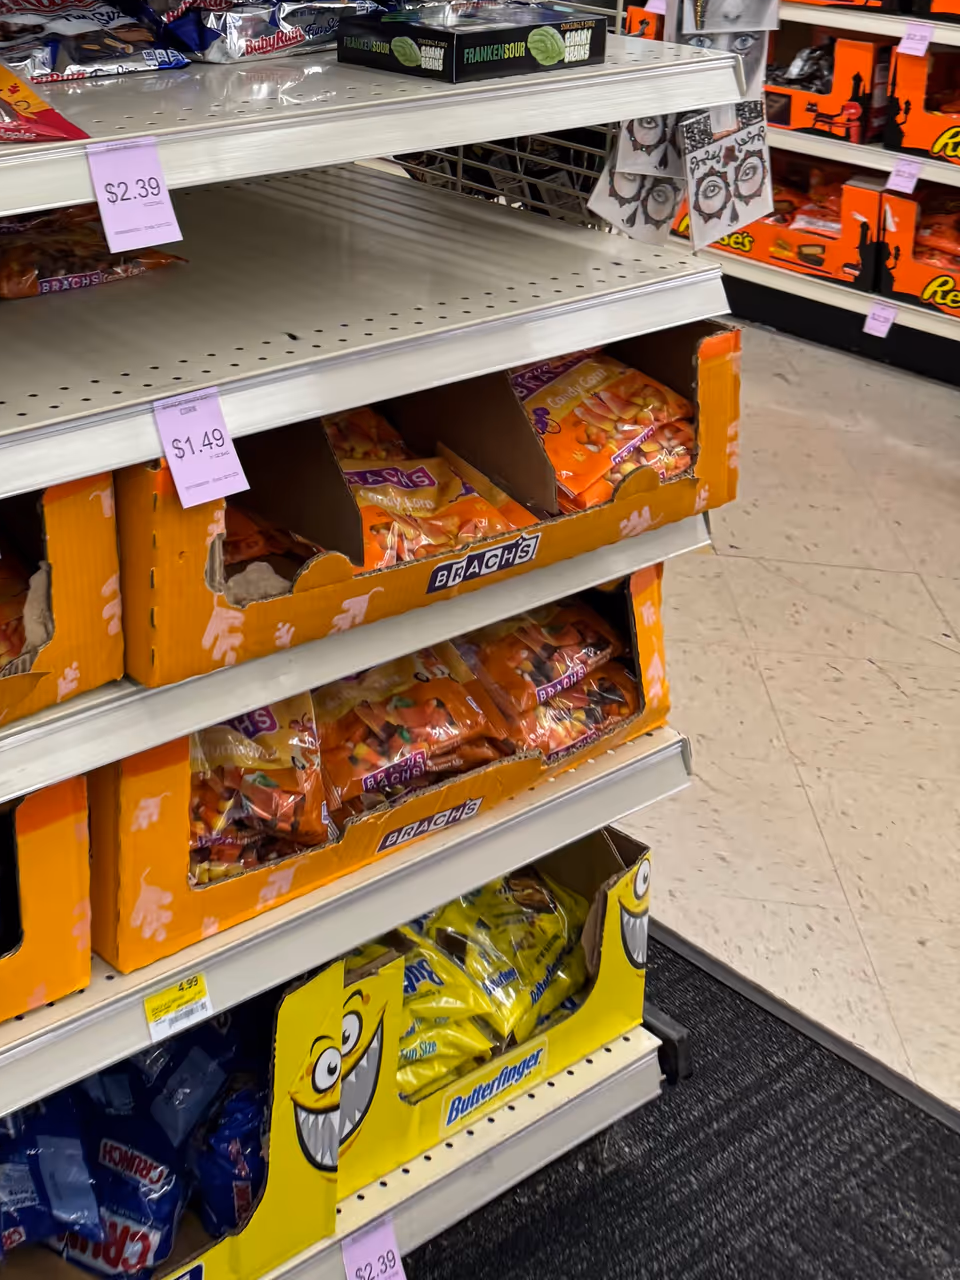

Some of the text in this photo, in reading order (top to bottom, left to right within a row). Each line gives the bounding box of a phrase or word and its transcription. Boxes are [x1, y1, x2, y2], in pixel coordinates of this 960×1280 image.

[565, 28, 592, 47] GUMMY
[564, 45, 590, 64] BRAINS
[105, 177, 161, 205] $2.39
[547, 368, 607, 410] Candy Corn
[171, 428, 225, 460] $1.49
[419, 1040, 437, 1058] Size
[446, 1047, 544, 1127] Butterfinger
[101, 1143, 167, 1187] CRUNCH
[355, 1249, 396, 1280] $2.39
